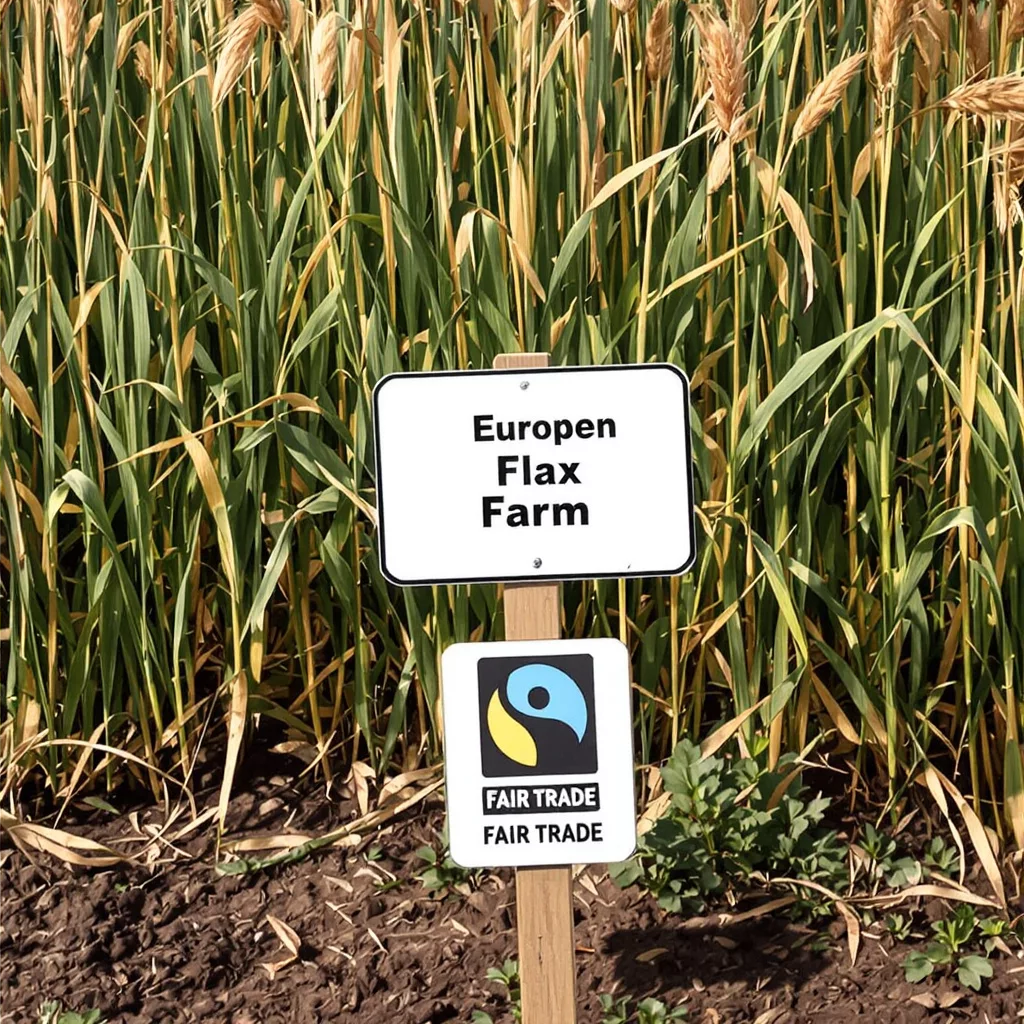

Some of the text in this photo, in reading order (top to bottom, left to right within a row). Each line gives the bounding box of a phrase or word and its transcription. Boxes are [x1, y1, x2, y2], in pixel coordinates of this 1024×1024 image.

[473, 414, 617, 446] Europen
[497, 455, 582, 486] Flax
[482, 495, 590, 528] Farm
[486, 787, 597, 809] FAIR TRADE
[483, 822, 603, 845] FAIR TRADE
